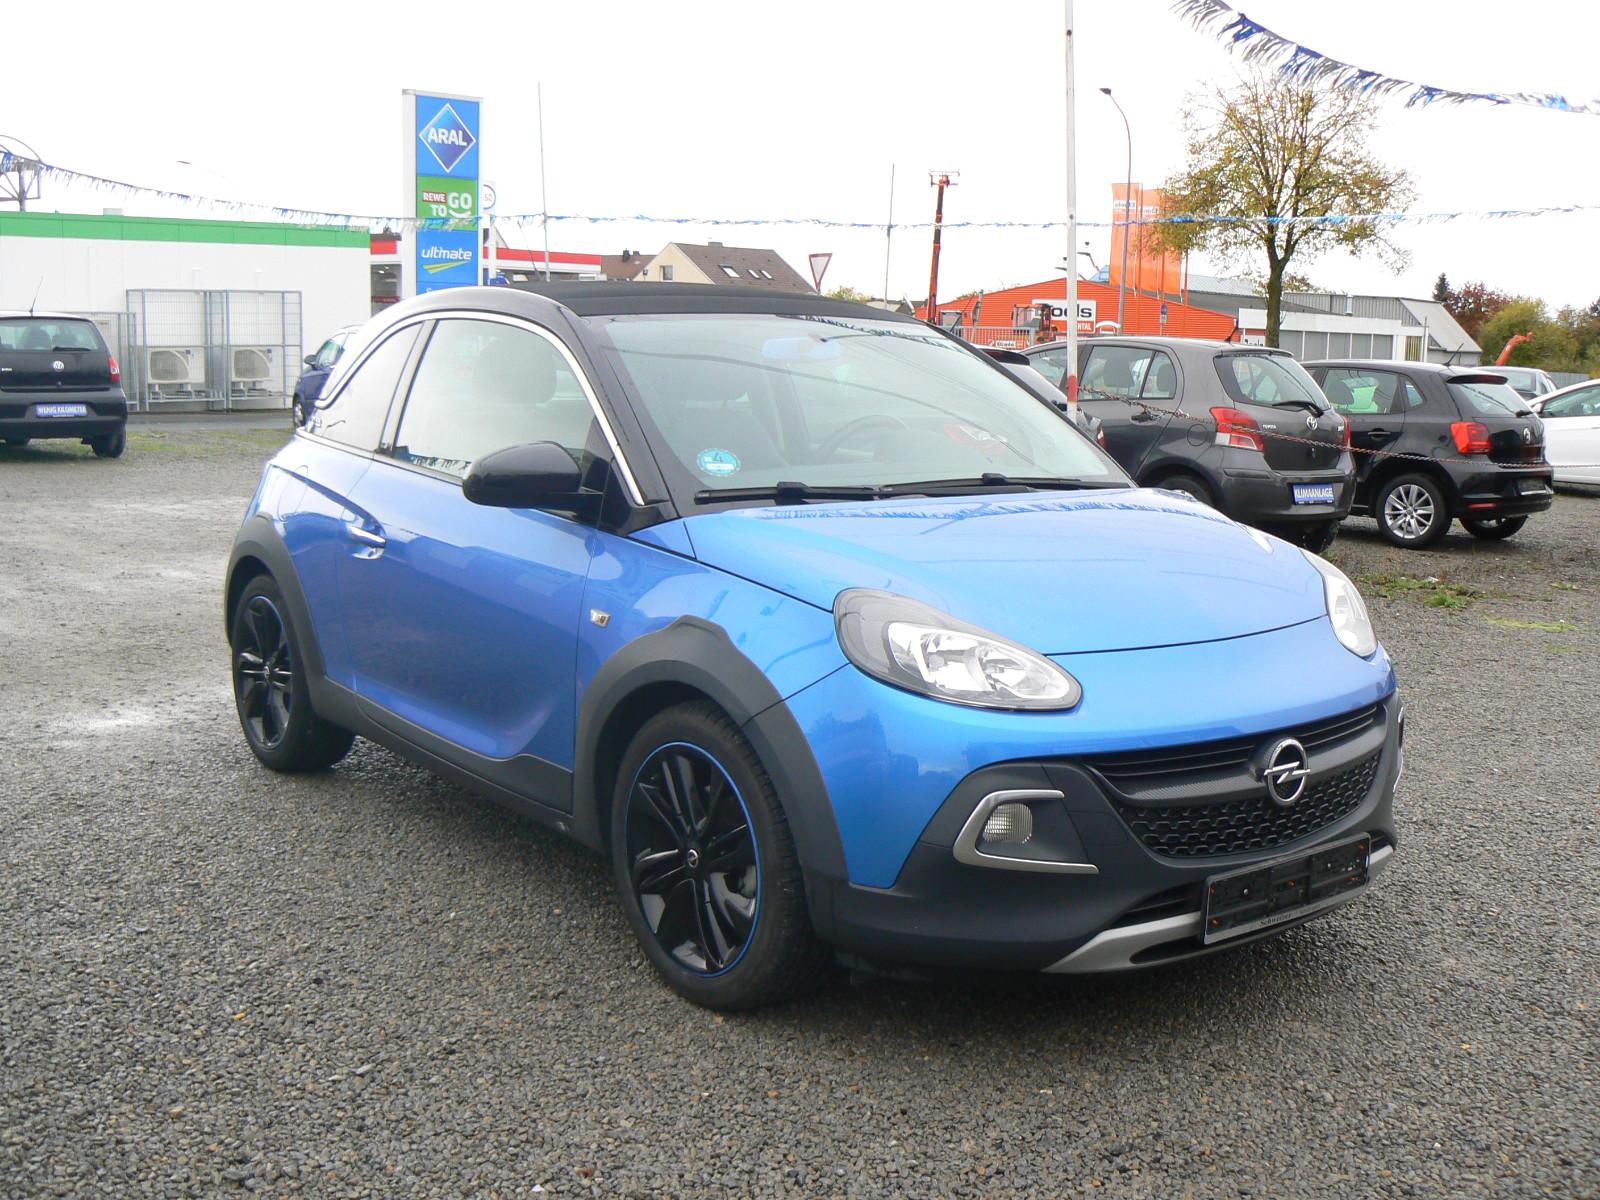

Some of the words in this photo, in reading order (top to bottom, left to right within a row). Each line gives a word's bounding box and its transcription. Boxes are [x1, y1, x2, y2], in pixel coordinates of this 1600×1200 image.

[428, 127, 467, 146] ARAL
[422, 191, 446, 202] REWE
[448, 192, 472, 209] GO
[431, 204, 447, 216] TO
[421, 246, 472, 260] ultimate
[1295, 487, 1333, 498] KLIMAANLAGE
